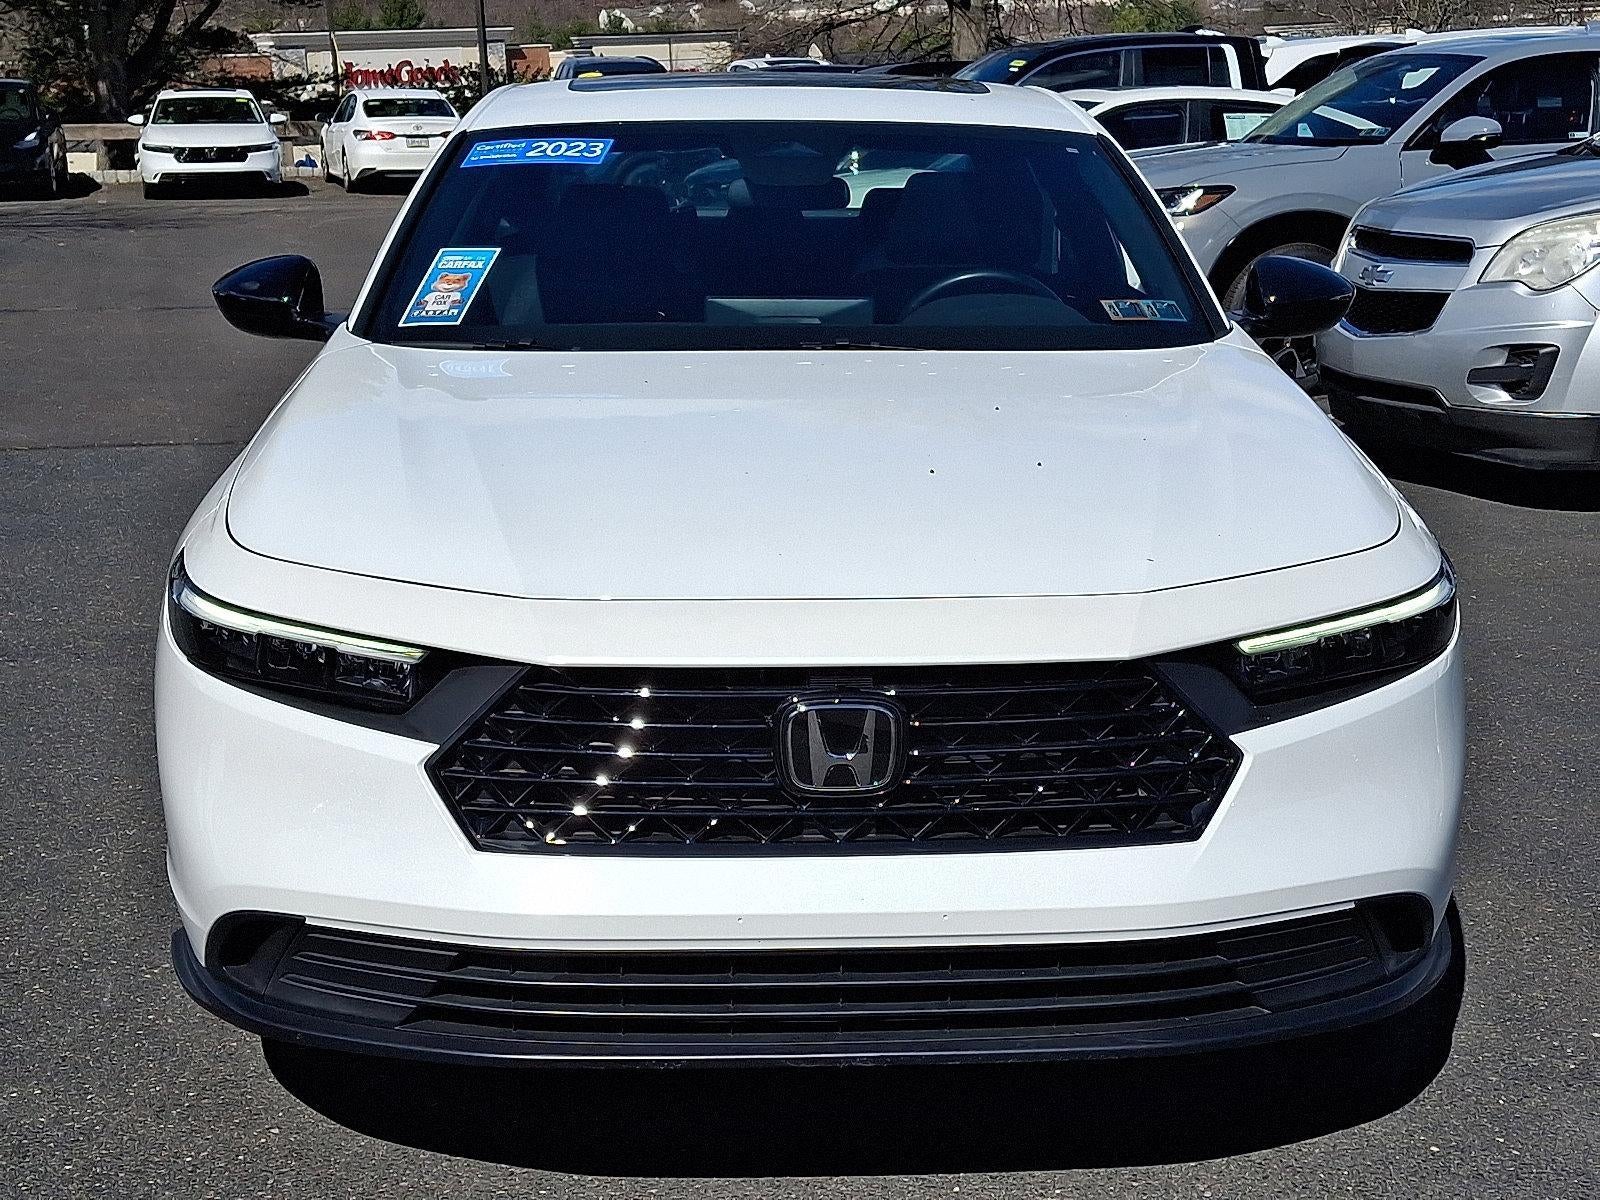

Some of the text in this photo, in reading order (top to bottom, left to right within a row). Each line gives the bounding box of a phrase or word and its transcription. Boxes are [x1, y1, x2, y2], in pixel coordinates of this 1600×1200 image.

[476, 141, 526, 151] Certified
[525, 141, 605, 158] 2023
[437, 260, 486, 269] CARFAX
